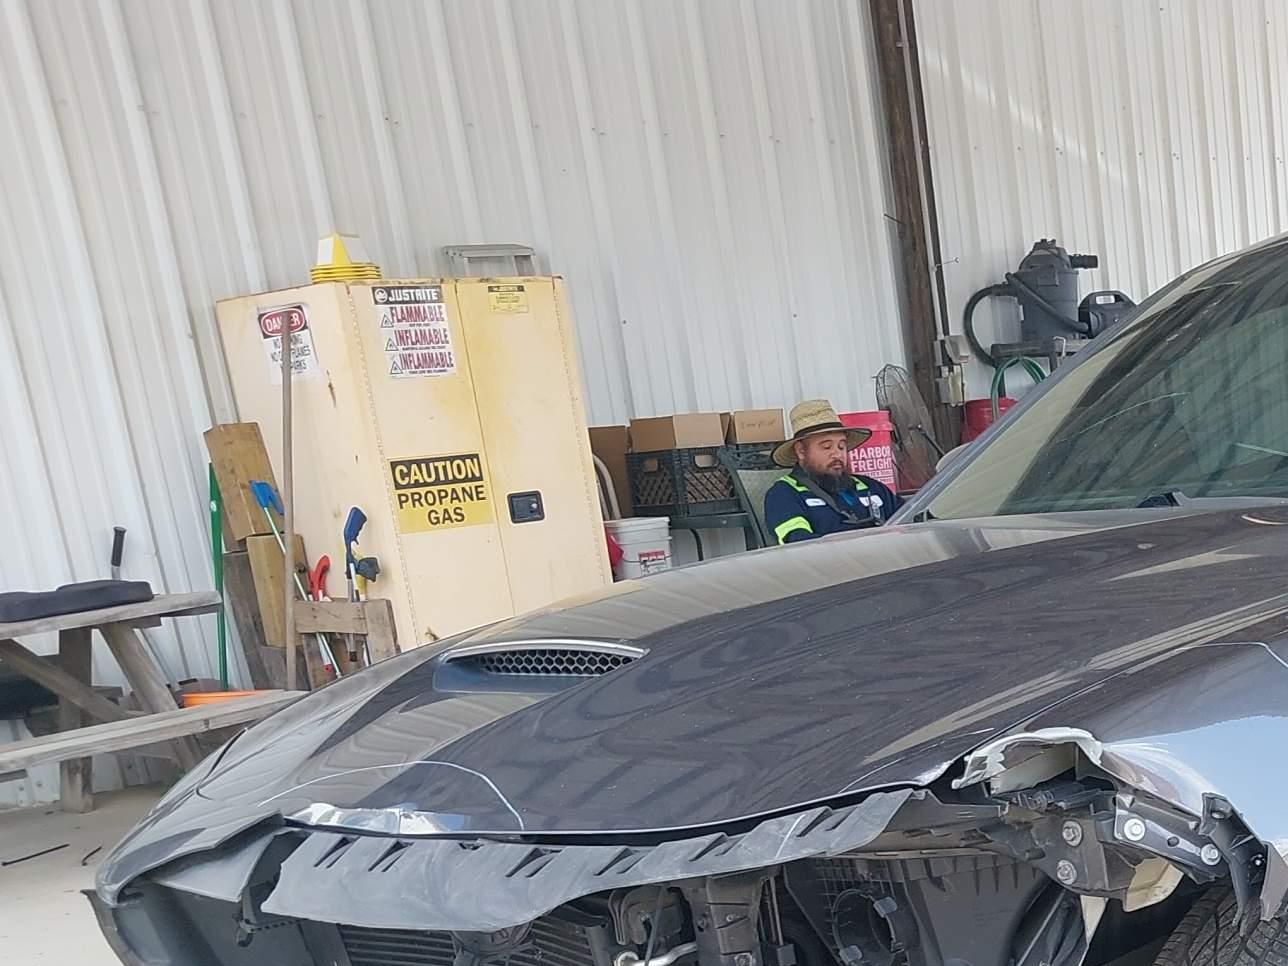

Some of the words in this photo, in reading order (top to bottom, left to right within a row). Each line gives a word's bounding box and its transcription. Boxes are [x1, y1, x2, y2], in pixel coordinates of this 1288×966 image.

[388, 288, 440, 302] JUSTRITE
[264, 312, 301, 332] DANER
[389, 304, 445, 323] FLAMMABLE
[394, 328, 450, 346] INFLAMABLE
[399, 351, 454, 370] INFLAMMABLE
[394, 457, 480, 485] CAUTION
[397, 484, 487, 509] PROPANE
[427, 506, 465, 526] GAS
